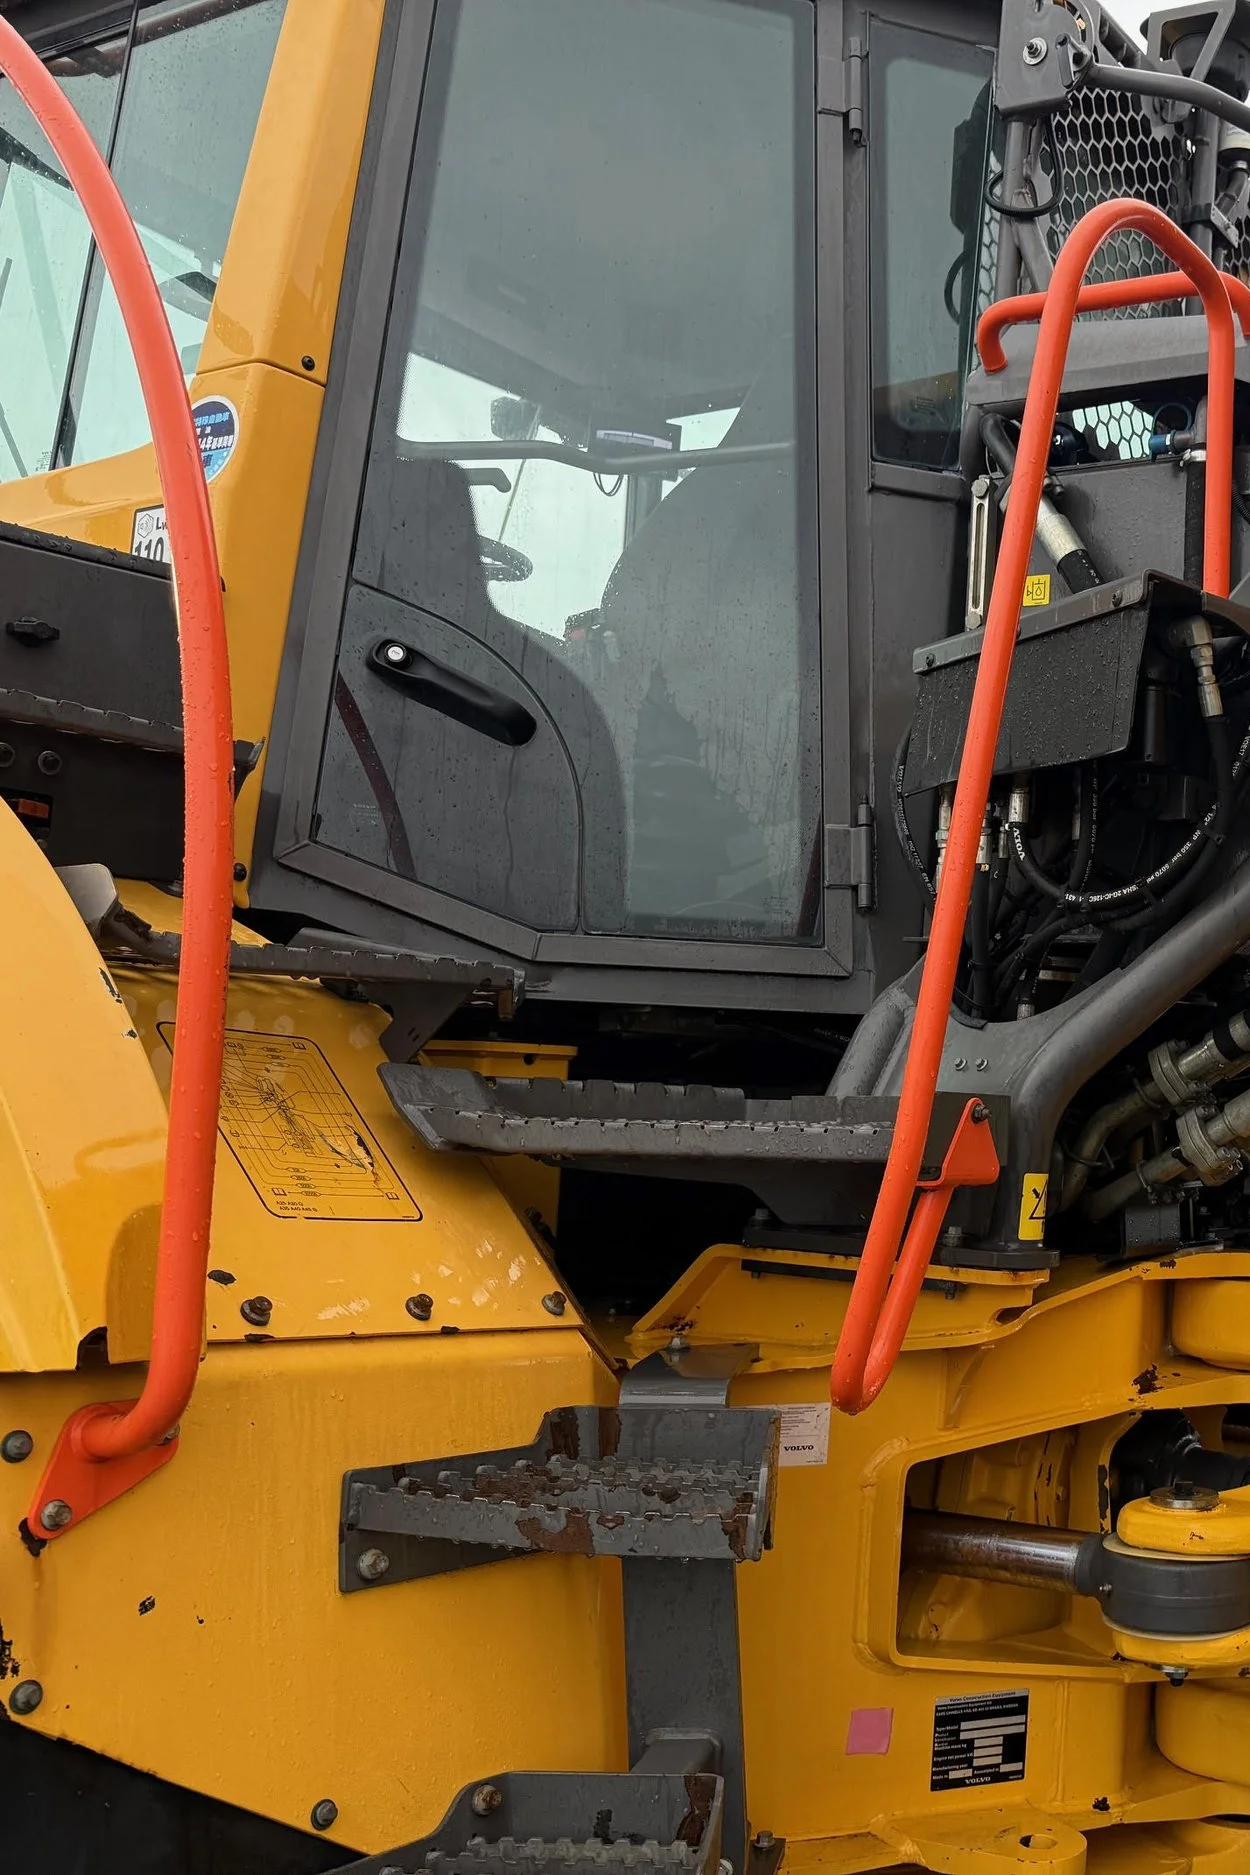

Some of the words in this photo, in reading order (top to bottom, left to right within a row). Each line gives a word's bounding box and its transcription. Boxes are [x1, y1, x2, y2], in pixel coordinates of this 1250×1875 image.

[1013, 827, 1025, 861] VOLV
[1181, 841, 1192, 853] 350
[1171, 852, 1182, 863] bar
[965, 1776, 991, 1784] VOLVO
